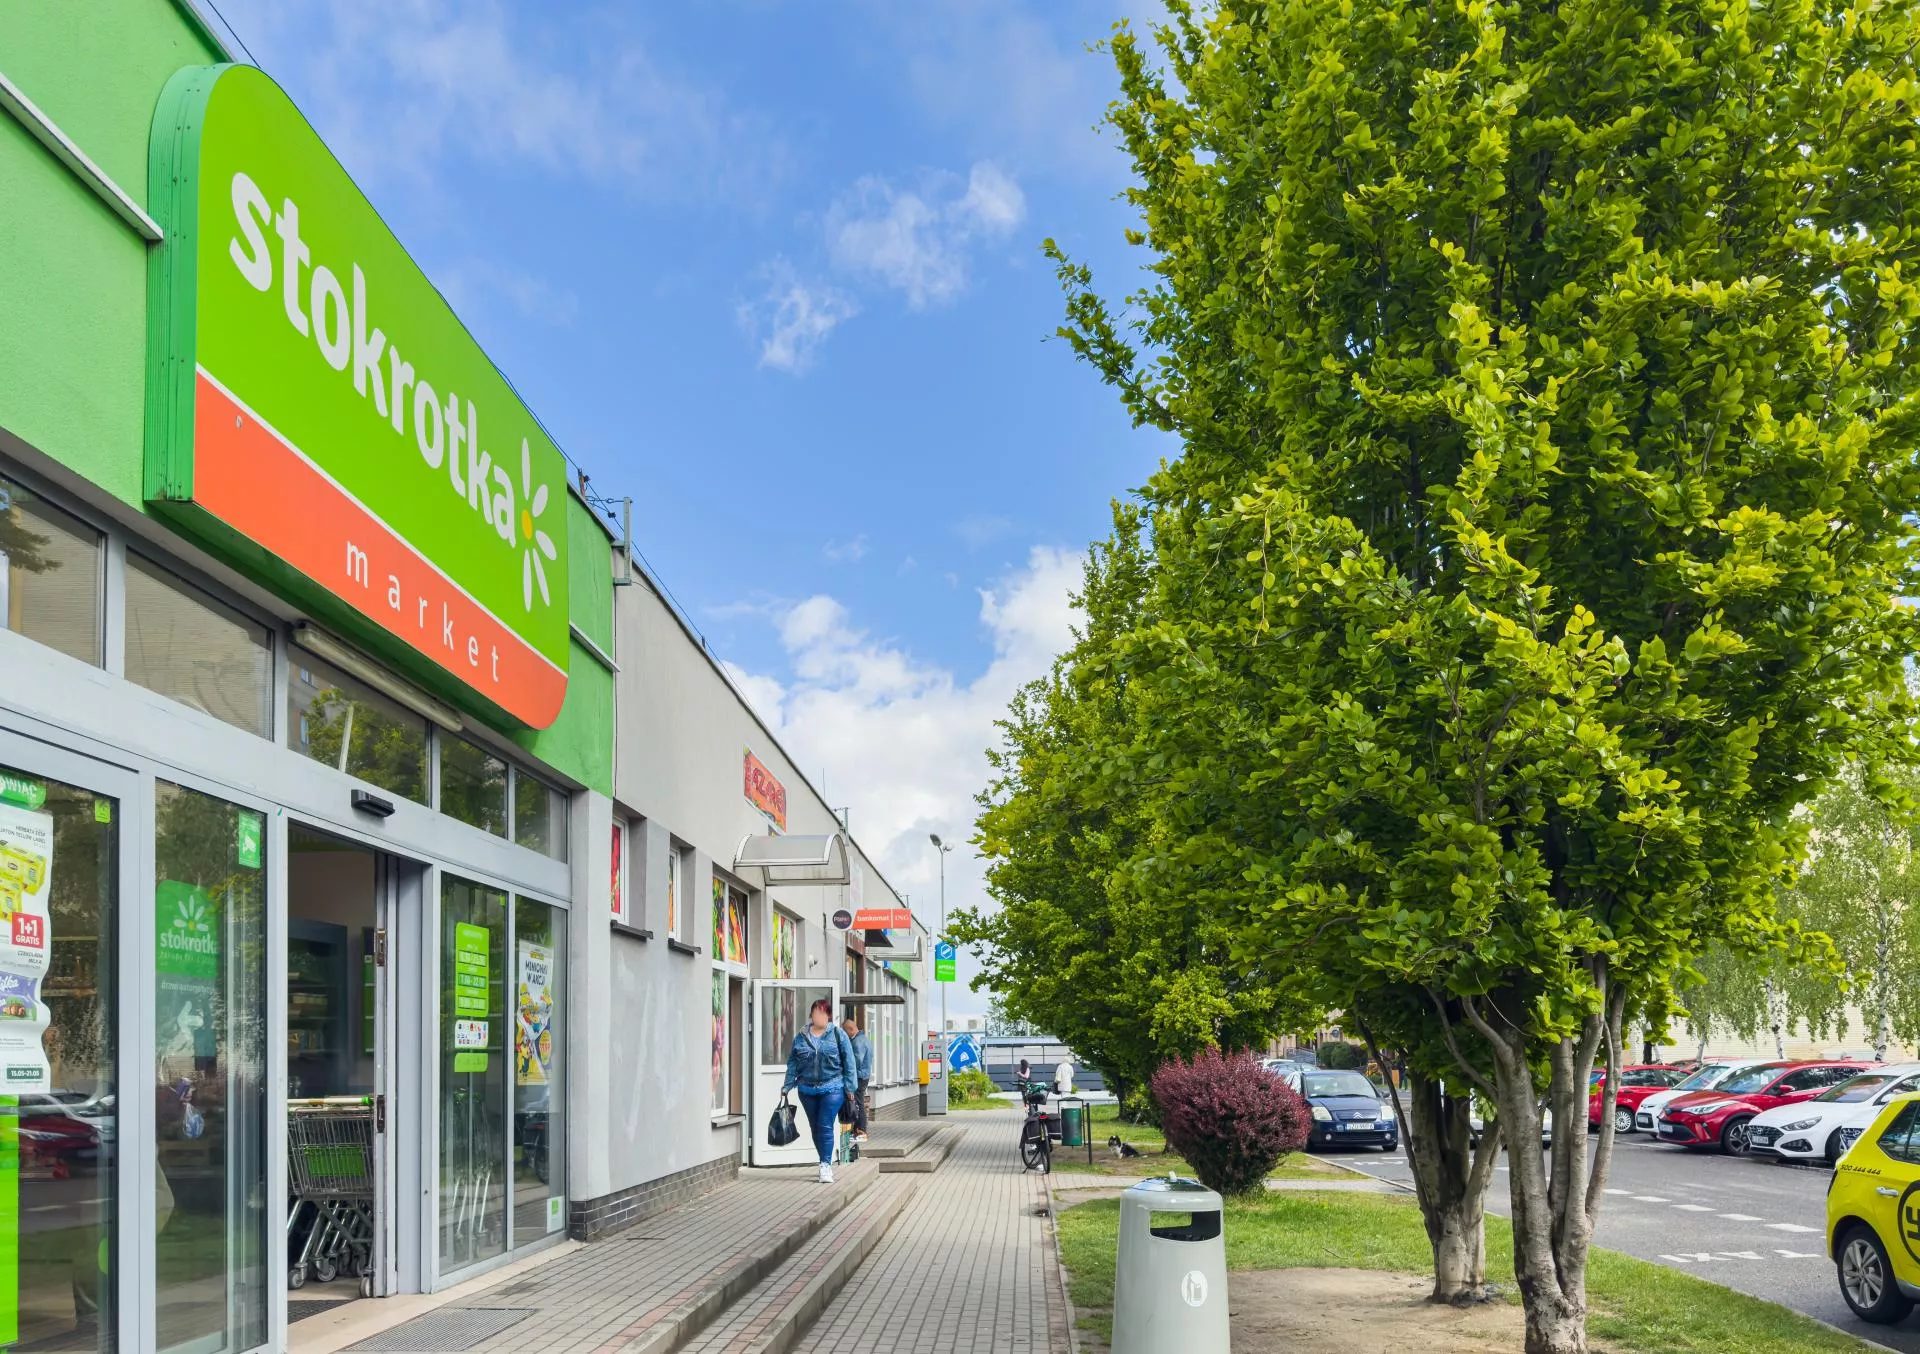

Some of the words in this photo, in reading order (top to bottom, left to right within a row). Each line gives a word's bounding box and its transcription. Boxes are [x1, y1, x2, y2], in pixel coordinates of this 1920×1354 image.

[229, 171, 517, 548] stokrotka
[345, 540, 500, 683] market
[18, 917, 38, 937] 1+1
[857, 914, 890, 922] bankomat
[16, 935, 40, 945] GRATIS
